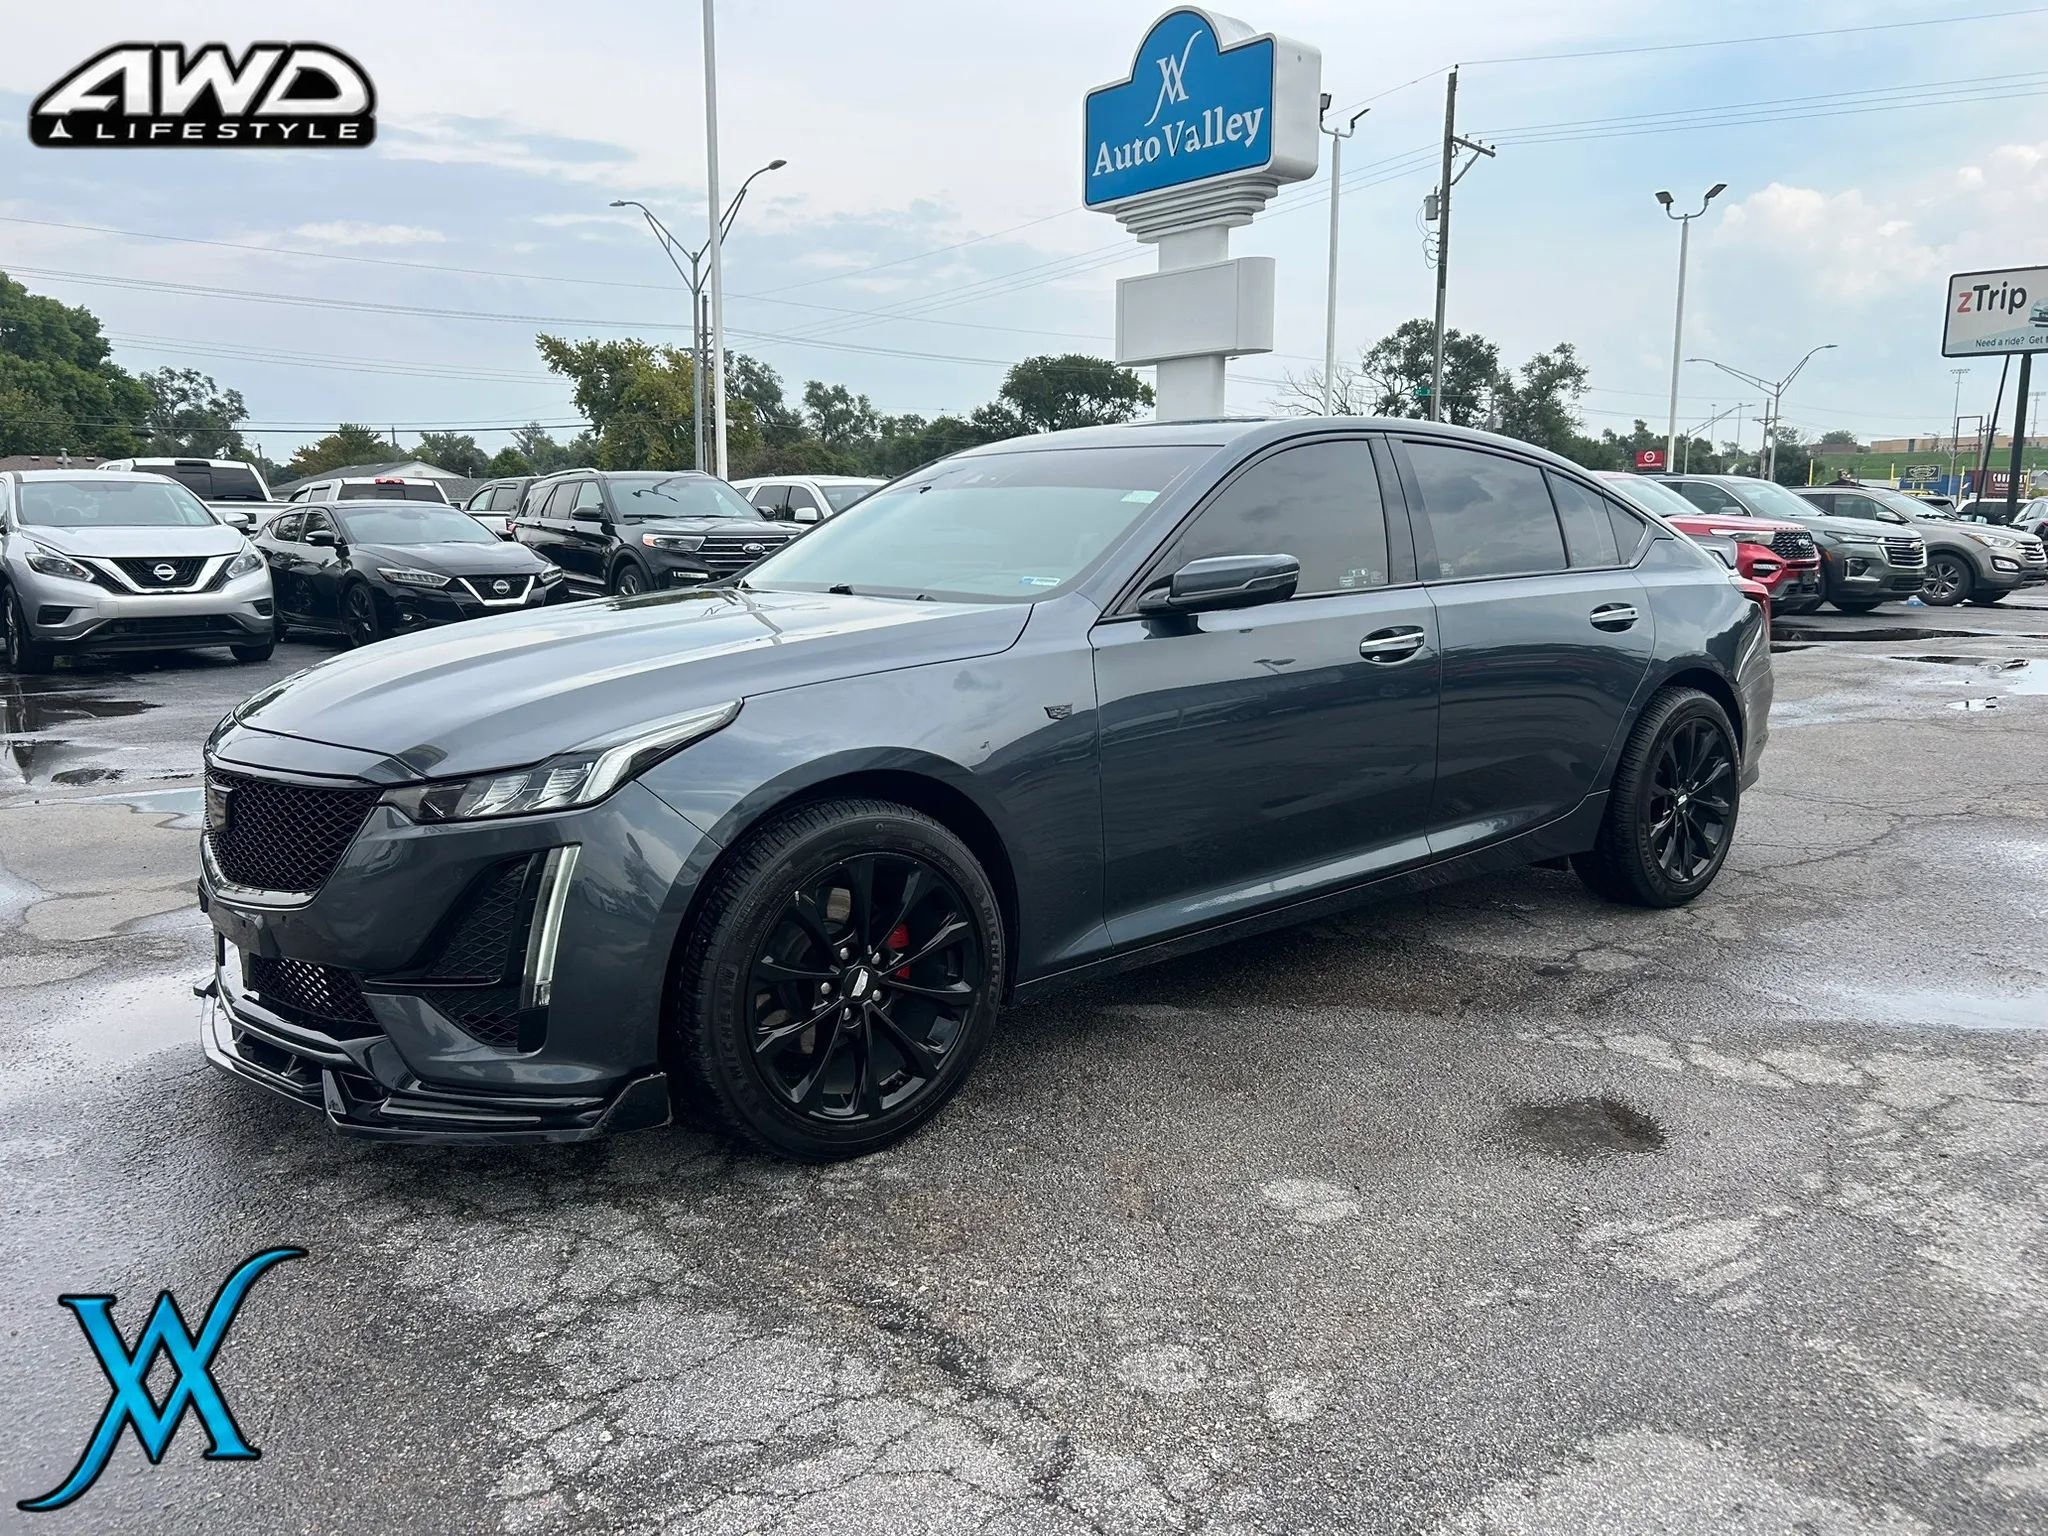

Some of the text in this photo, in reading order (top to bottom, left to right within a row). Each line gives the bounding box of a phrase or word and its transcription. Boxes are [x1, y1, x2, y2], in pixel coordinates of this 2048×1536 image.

[1957, 281, 2027, 315] zTrip
[1976, 338, 1996, 347] Need
[2005, 337, 2025, 346] ride?
[2029, 336, 2043, 344] Get
